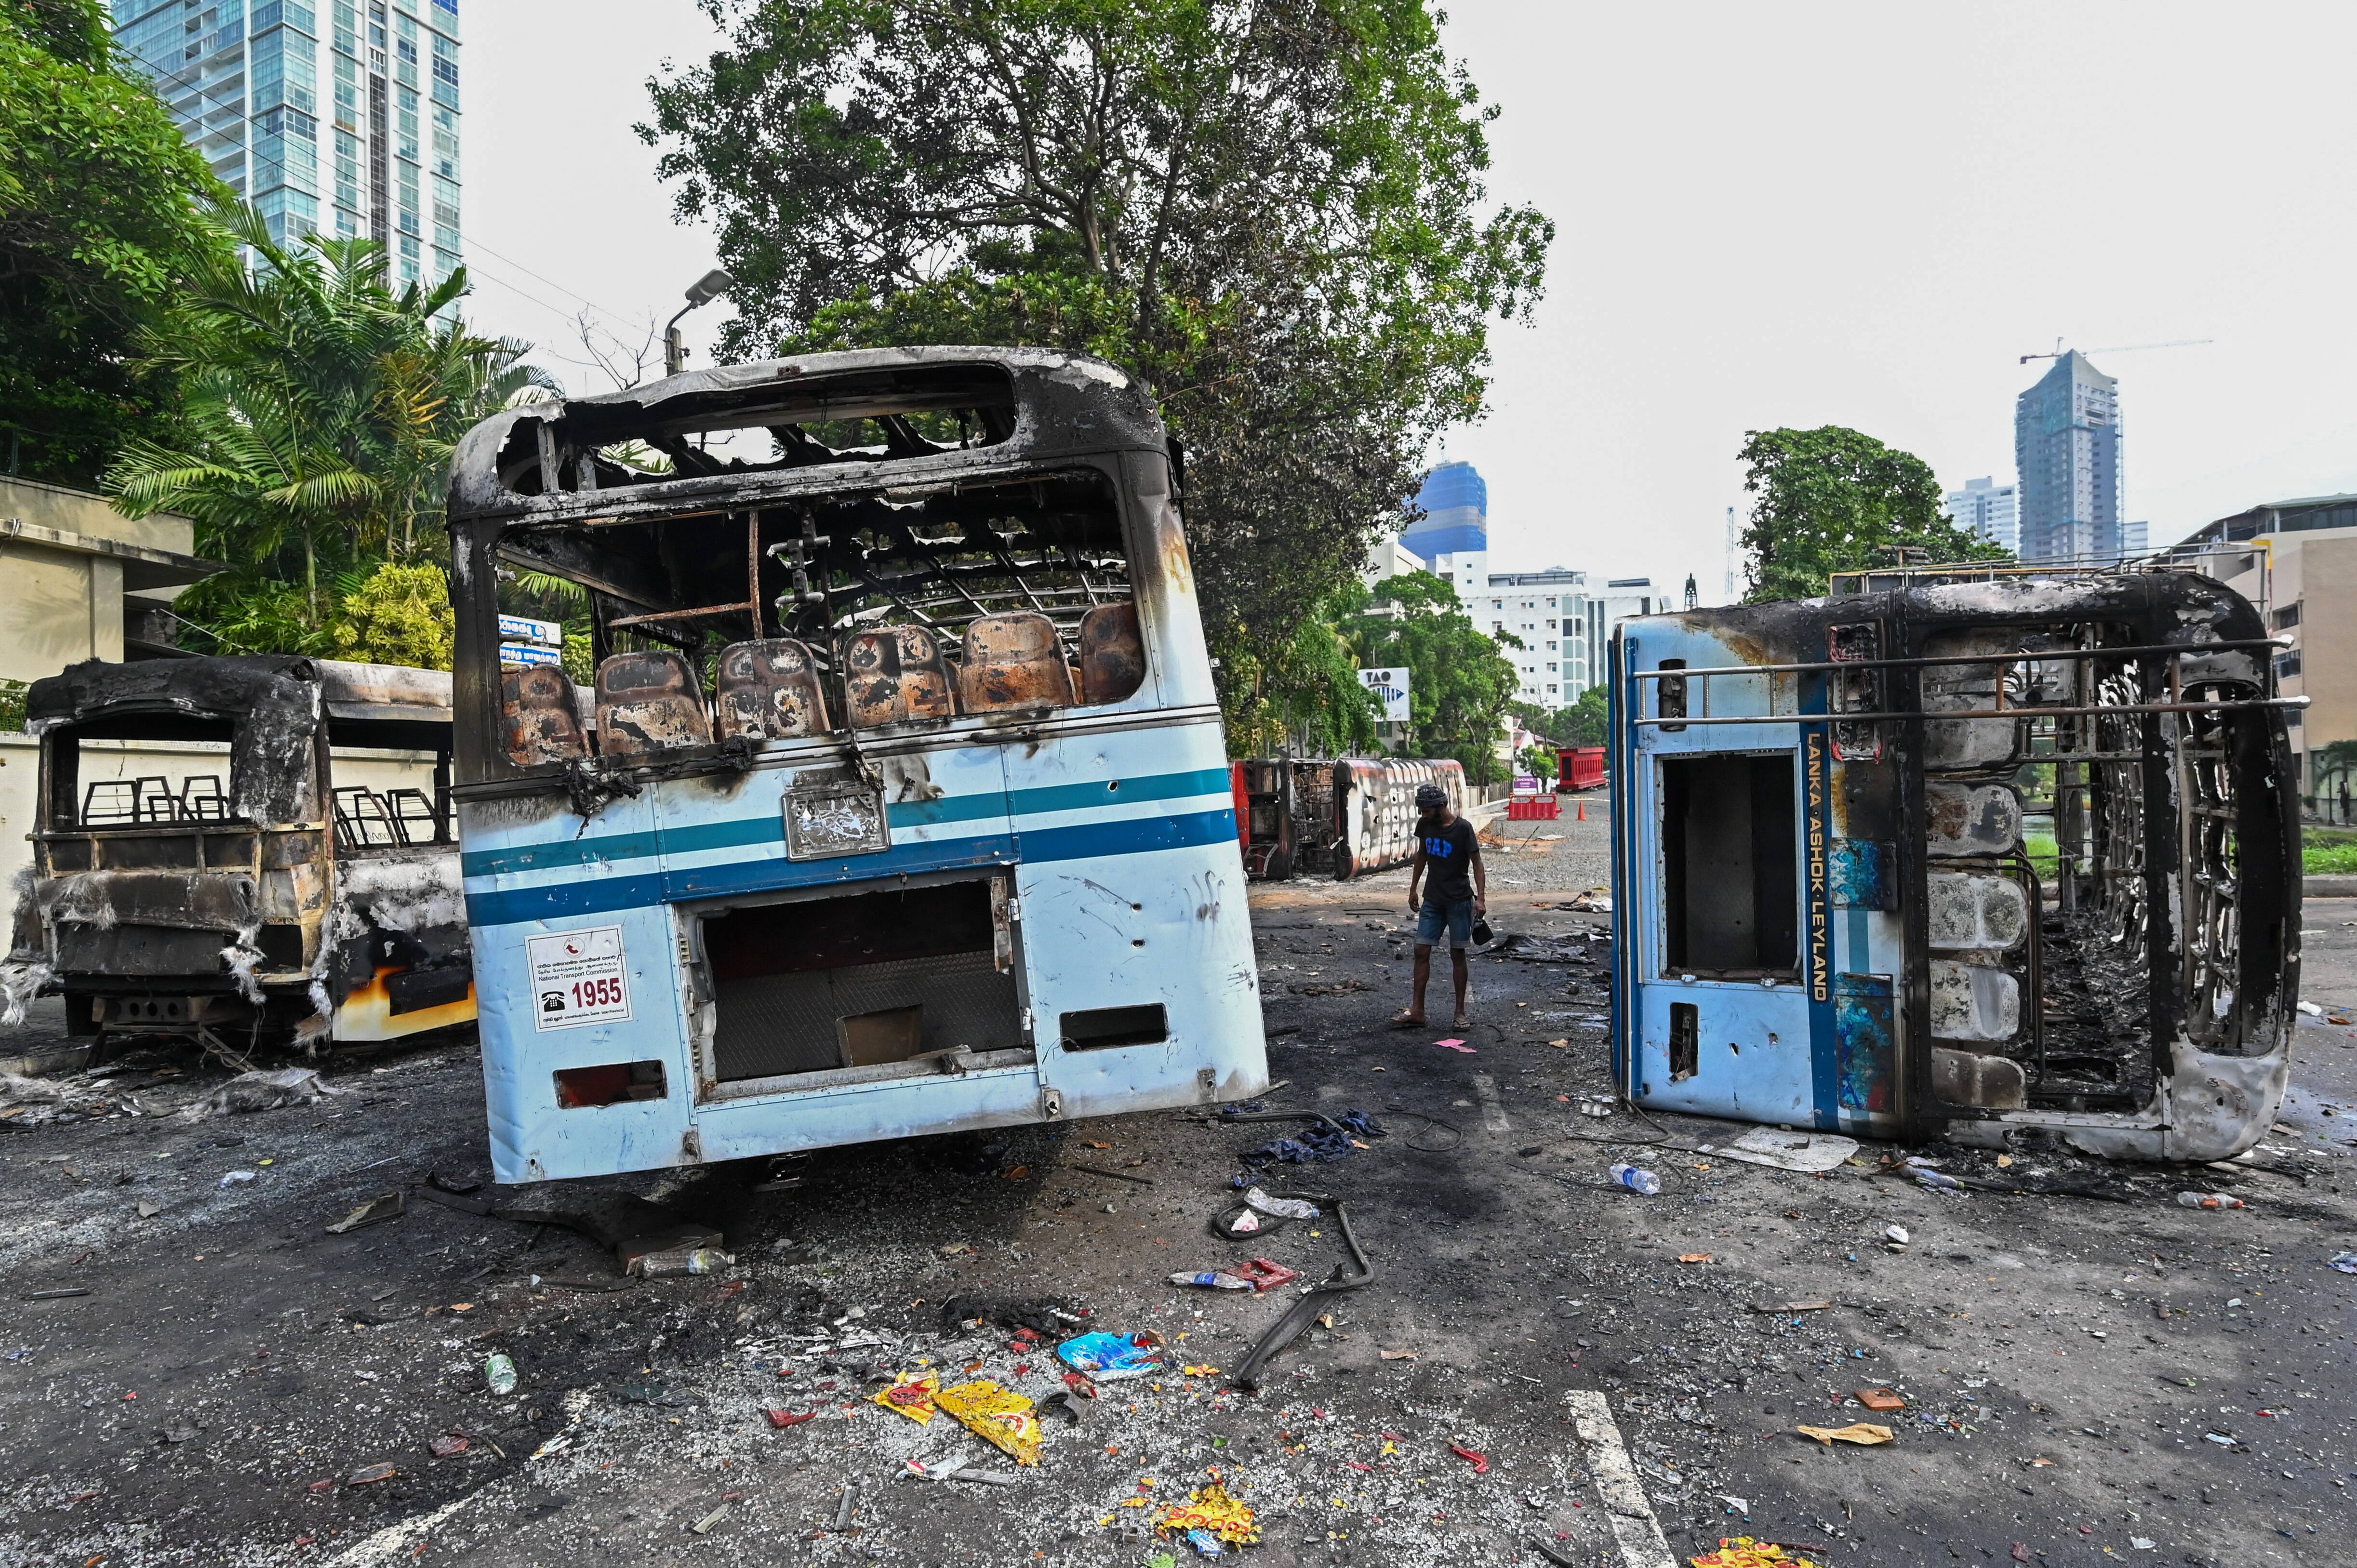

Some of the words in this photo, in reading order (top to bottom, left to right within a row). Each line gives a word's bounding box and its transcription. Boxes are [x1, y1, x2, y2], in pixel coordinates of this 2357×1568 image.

[1366, 671, 1391, 682] TAO
[1808, 733, 1822, 807] LANKA
[1425, 836, 1453, 859] GAP
[1810, 816, 1824, 892] ASHOK
[1812, 902, 1827, 1002] LEYLAND
[586, 967, 618, 976] Commission
[572, 977, 622, 1008] 1955
